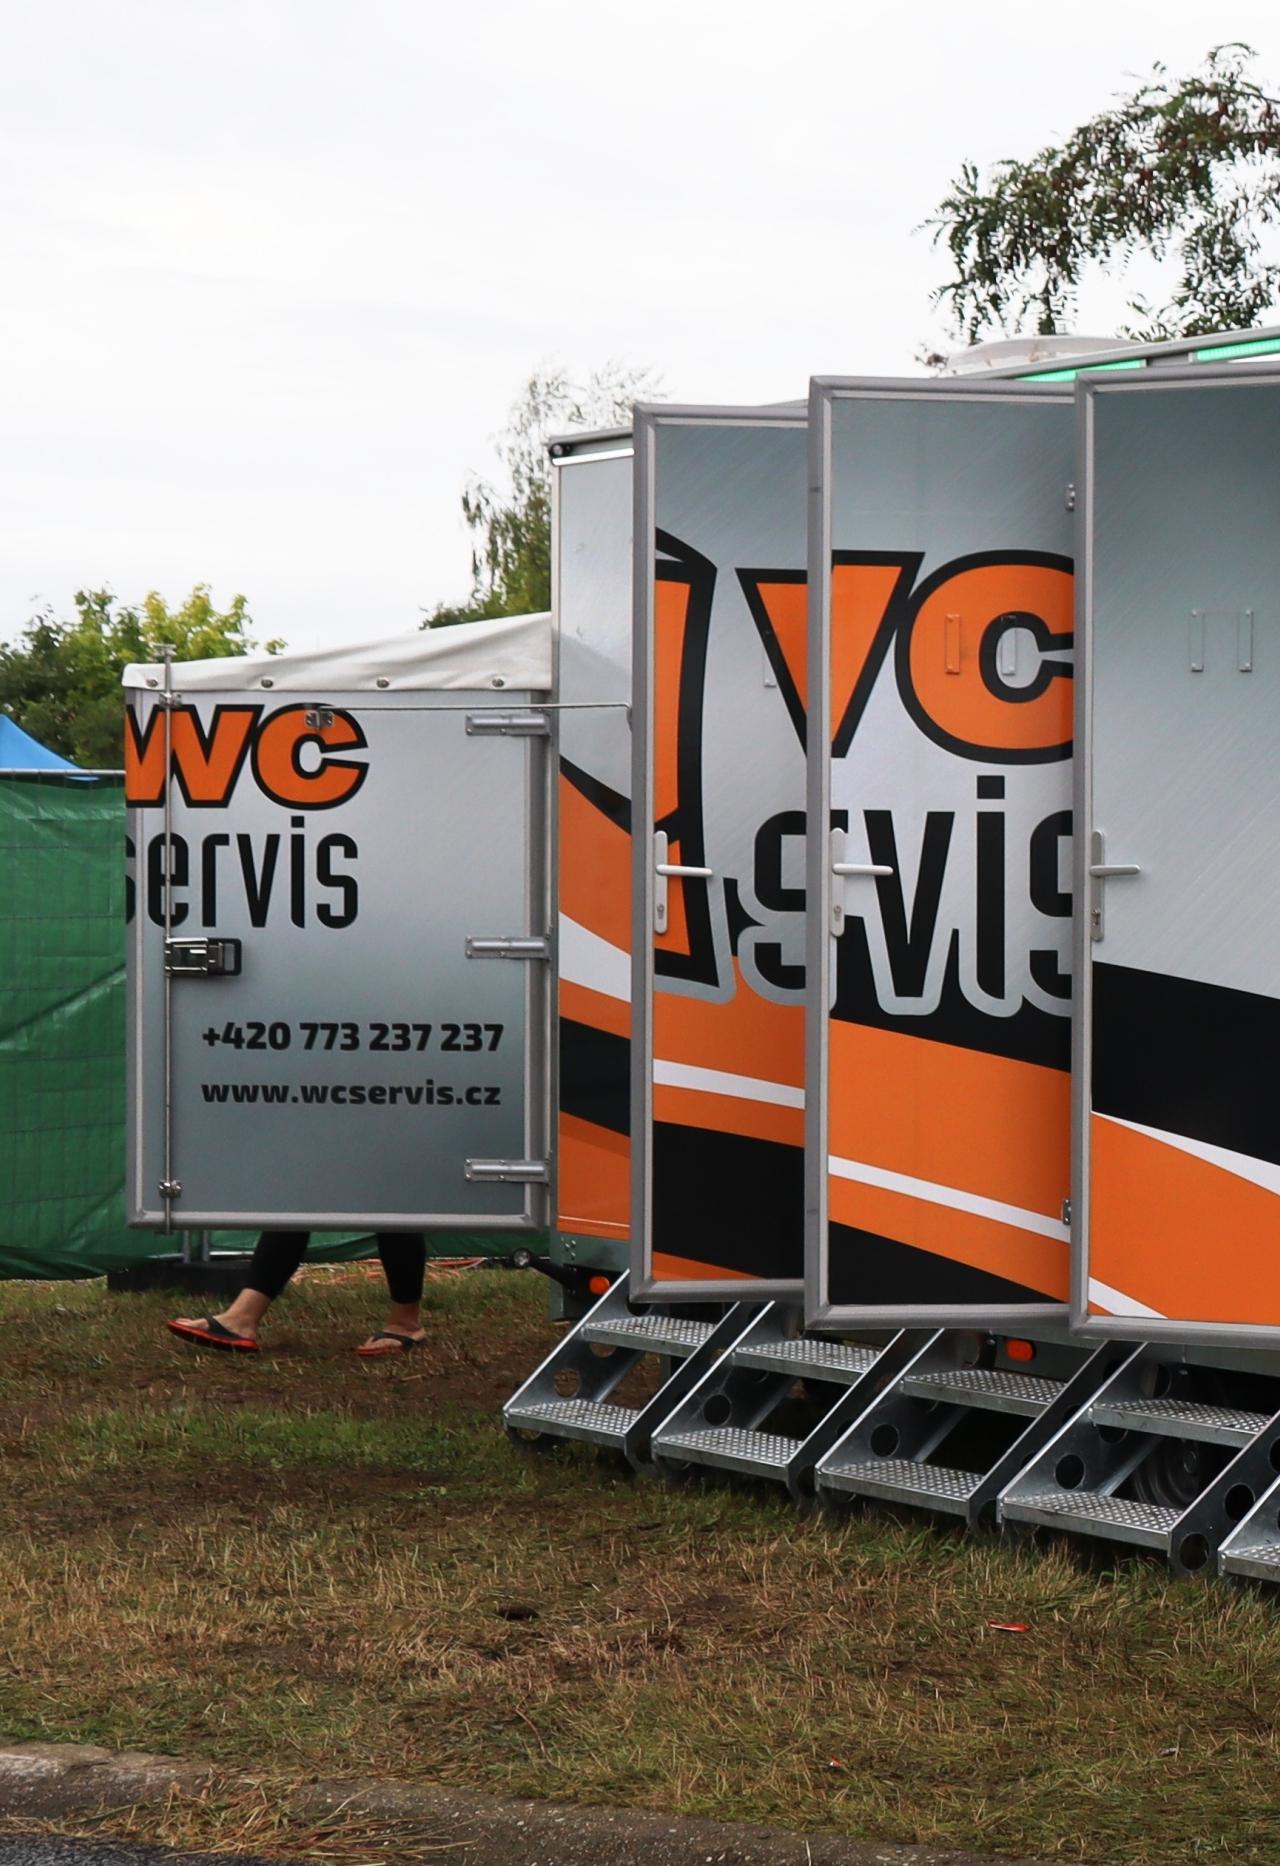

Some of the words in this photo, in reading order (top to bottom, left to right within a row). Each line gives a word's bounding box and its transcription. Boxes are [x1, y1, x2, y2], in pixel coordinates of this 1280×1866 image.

[126, 702, 370, 811] WC
[126, 815, 359, 930] ervis
[201, 1021, 291, 1050] +420
[299, 1022, 361, 1051] 773
[368, 1022, 433, 1052] 237
[440, 1022, 504, 1052] 237
[201, 1078, 501, 1106] www.wcservis.cz
